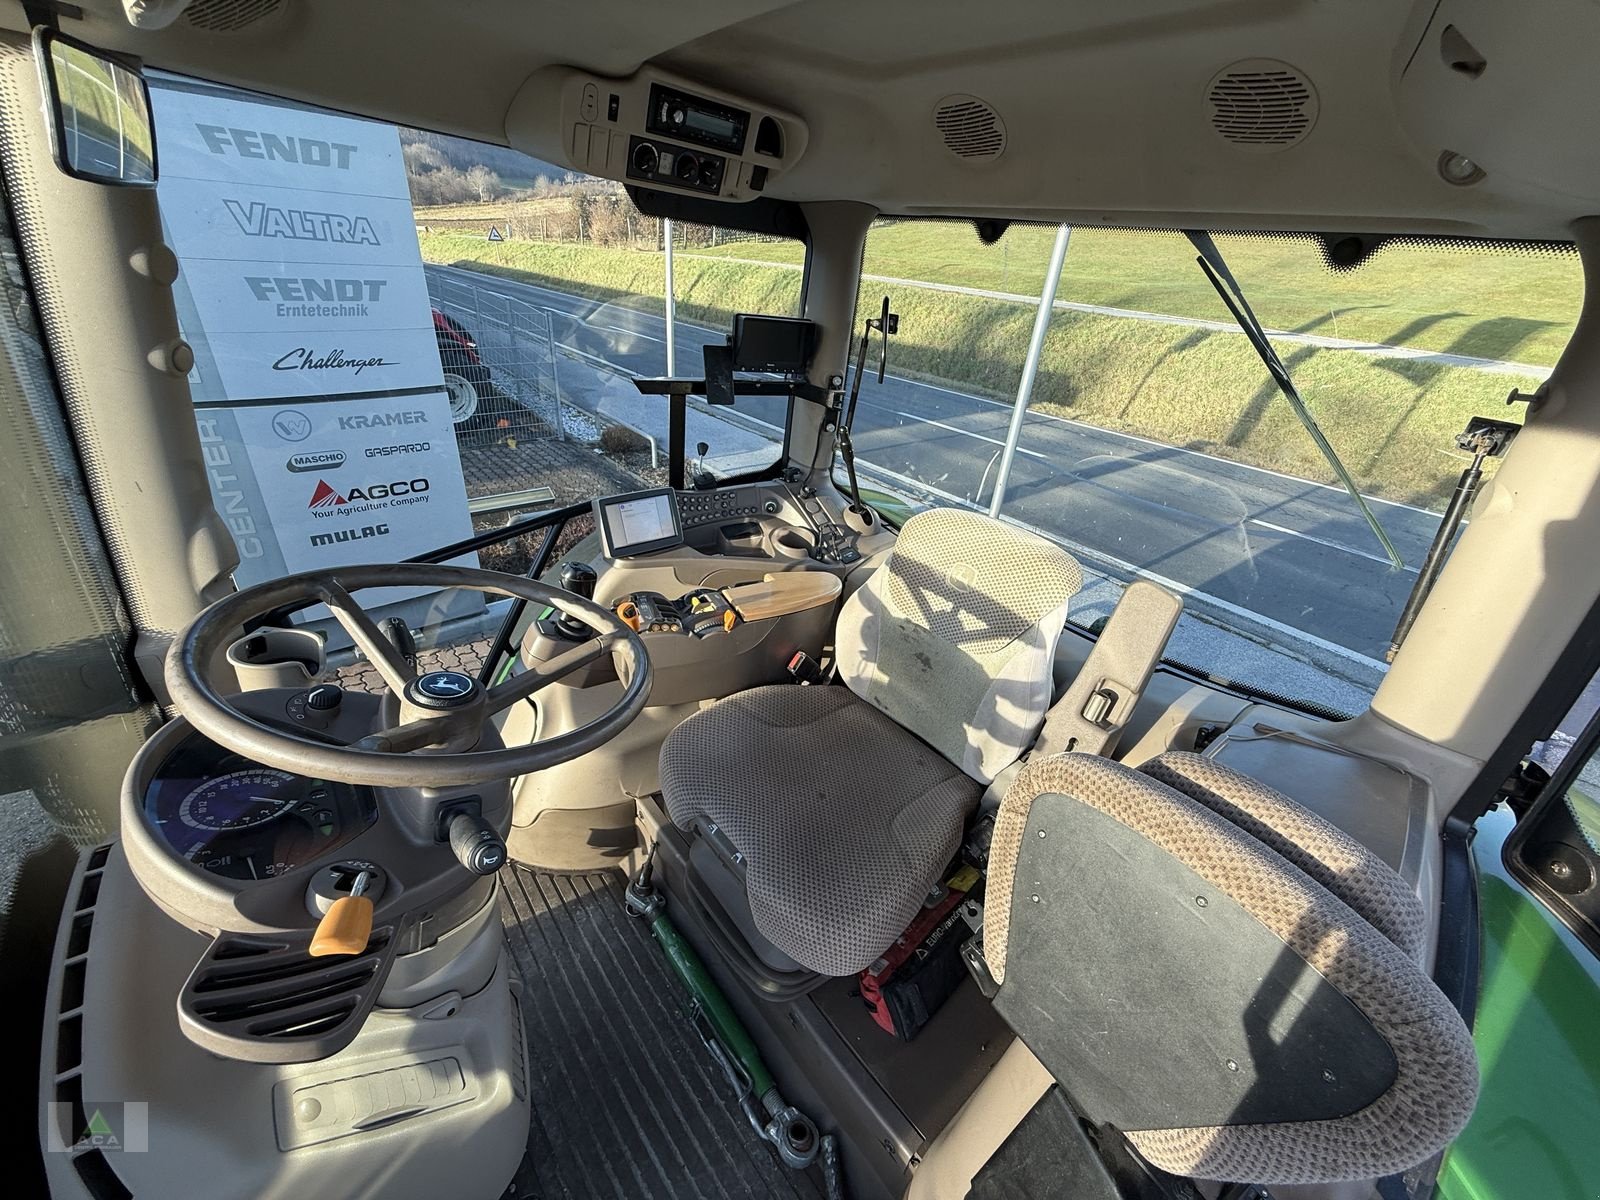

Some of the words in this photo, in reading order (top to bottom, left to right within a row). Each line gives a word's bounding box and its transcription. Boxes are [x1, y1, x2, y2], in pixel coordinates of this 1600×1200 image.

[195, 123, 357, 169] FENDT
[222, 199, 381, 246] VALTRA
[244, 277, 387, 301] FENDT
[276, 304, 368, 317] Erntetechnik
[272, 348, 400, 375] Challenger
[338, 411, 428, 430] KRAMER
[294, 453, 344, 465] MASCHIO
[365, 442, 430, 458] GASPARDO
[197, 418, 264, 559] CENTER
[347, 478, 430, 502] AGCO
[312, 511, 334, 519] Your
[337, 501, 388, 517] Agriculture
[390, 495, 430, 508] Company
